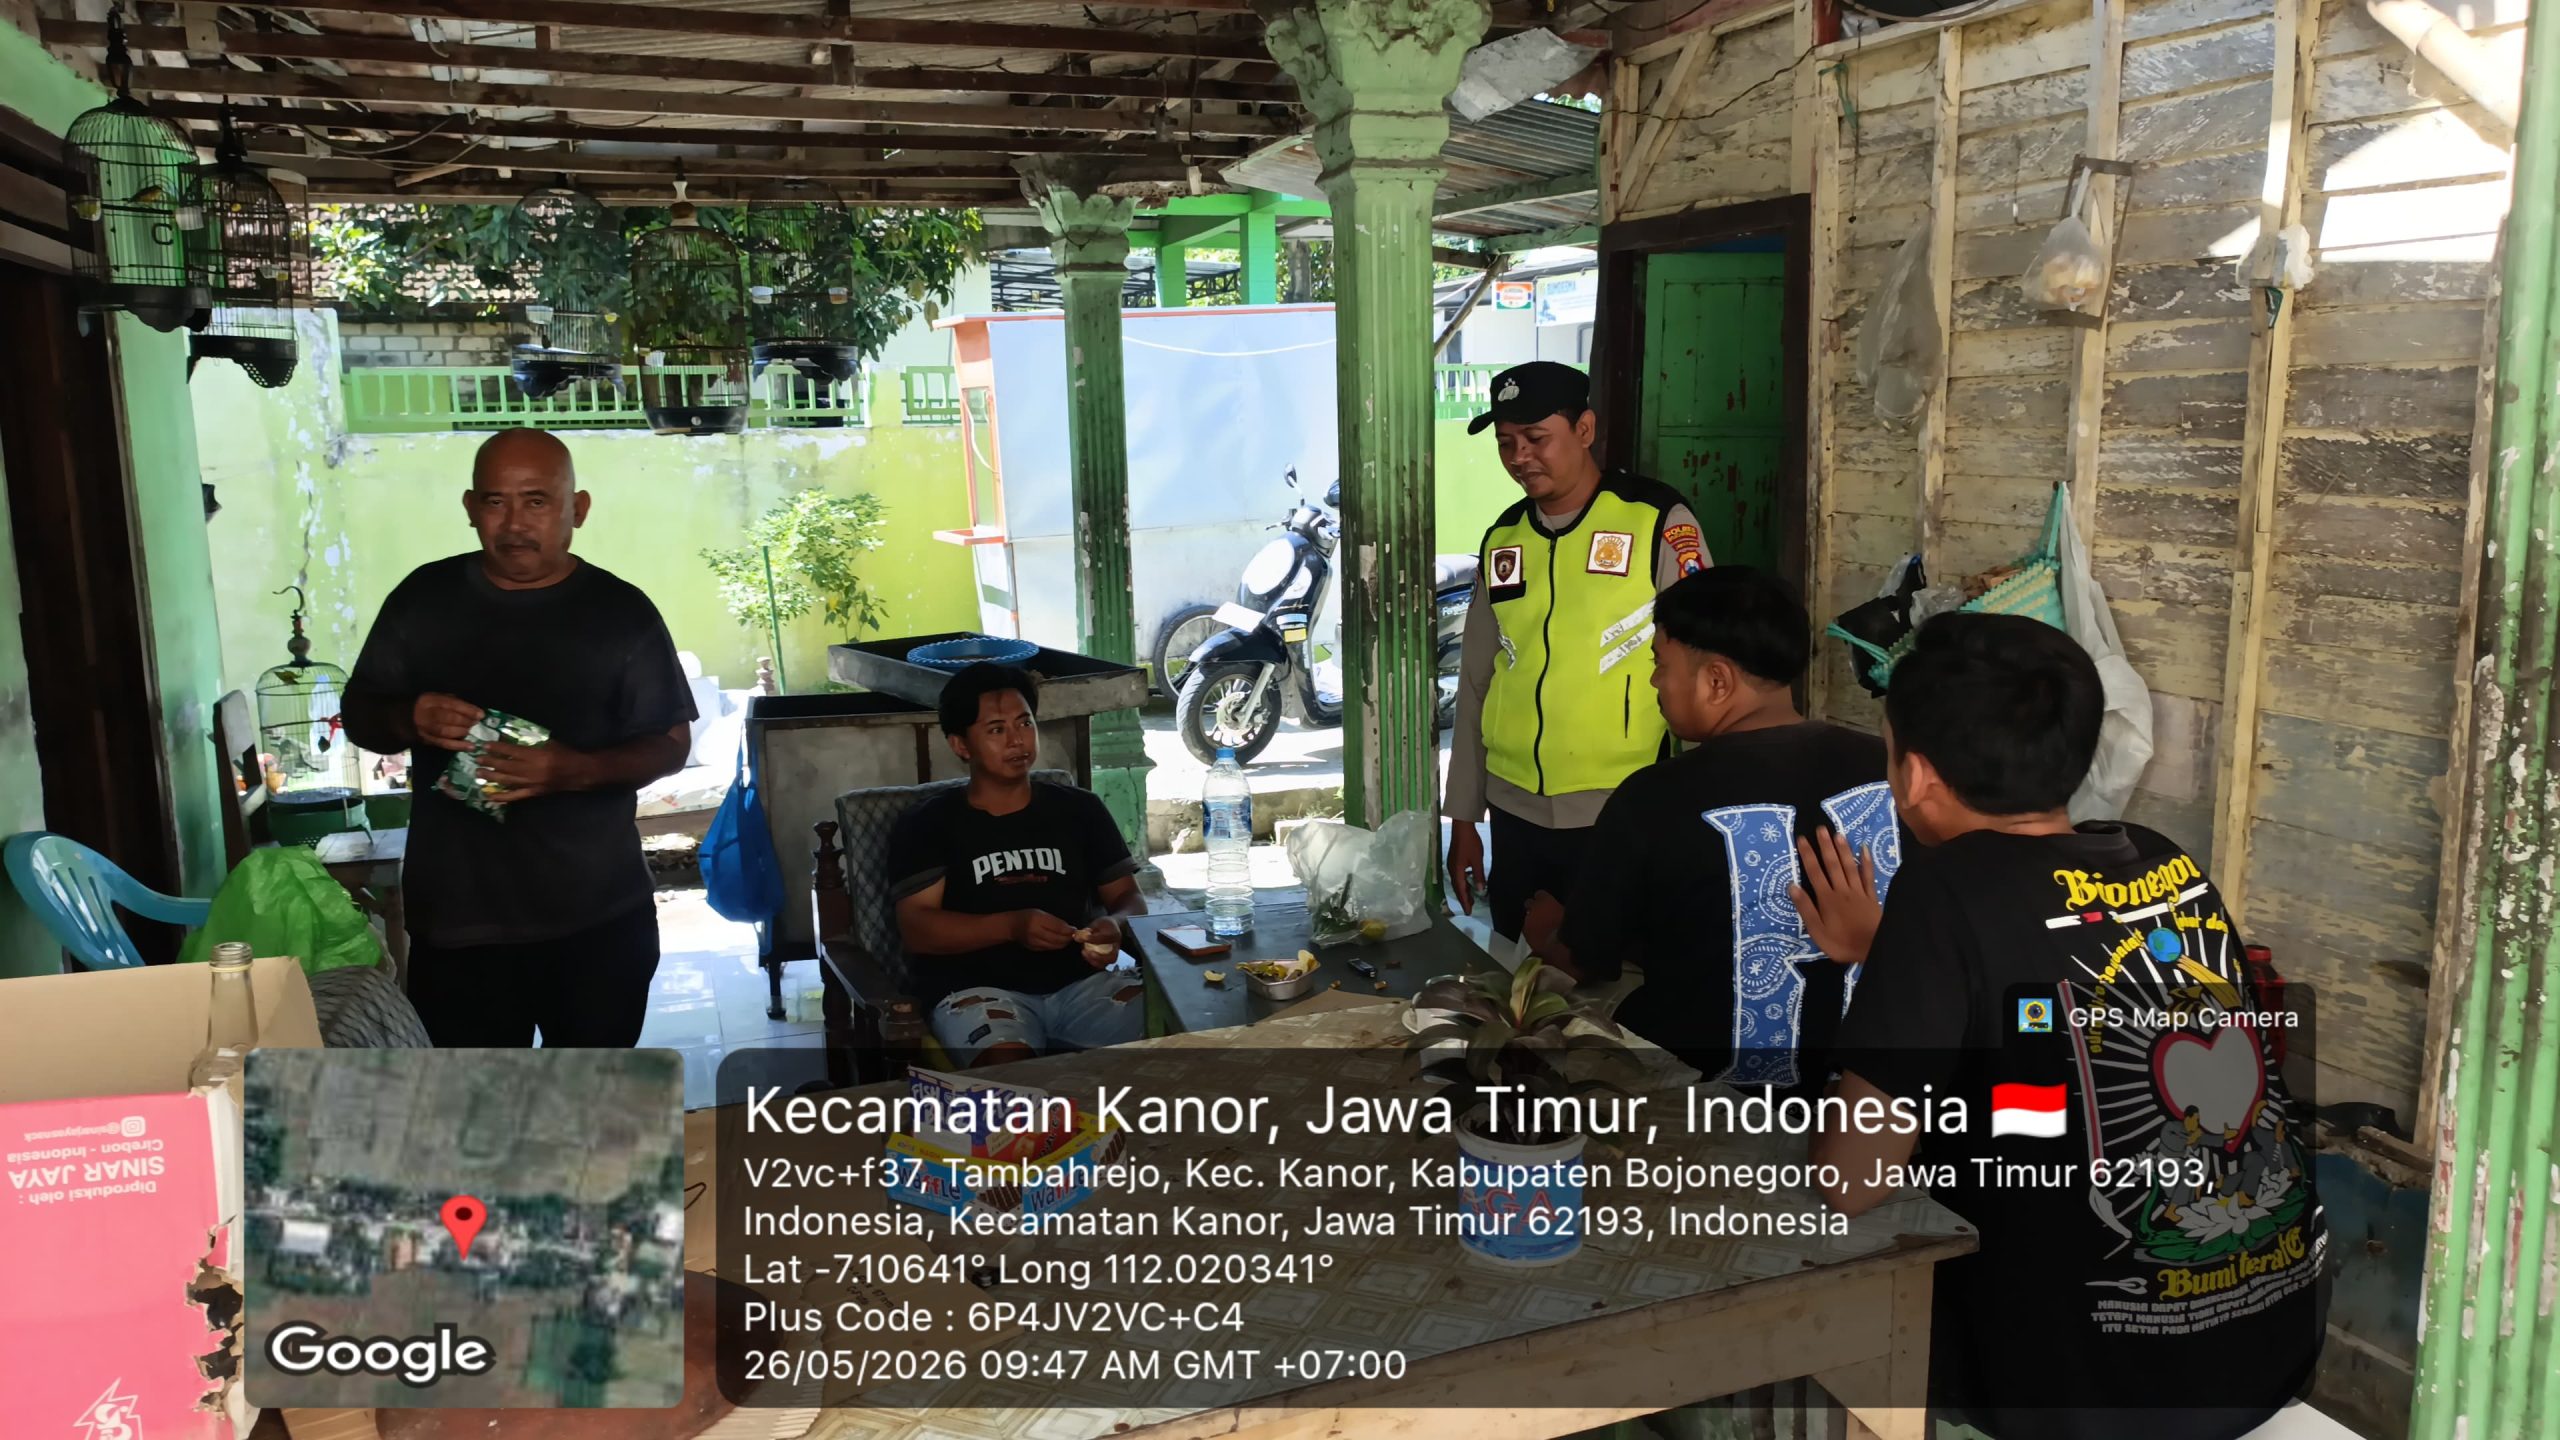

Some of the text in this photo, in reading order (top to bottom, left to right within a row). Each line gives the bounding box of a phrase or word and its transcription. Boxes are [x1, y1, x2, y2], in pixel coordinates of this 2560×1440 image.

[971, 847, 1067, 885] PENTOL
[24, 1122, 121, 1142] @sinarjayasnack
[101, 1139, 164, 1154] Cirebon
[7, 1146, 87, 1164] Indonesia
[8, 1156, 165, 1189] SINAR JAYA
[29, 1191, 65, 1206] oleh
[69, 1180, 157, 1202] Diproduksi
[2098, 1300, 2148, 1312] MANUSIA
[2091, 1312, 2133, 1322] TETAPI
[2136, 1313, 2186, 1323] MANUSIA
[2102, 1323, 2123, 1334] ITU
[2125, 1324, 2159, 1335] SETIA
[2162, 1324, 2190, 1335] PADA
